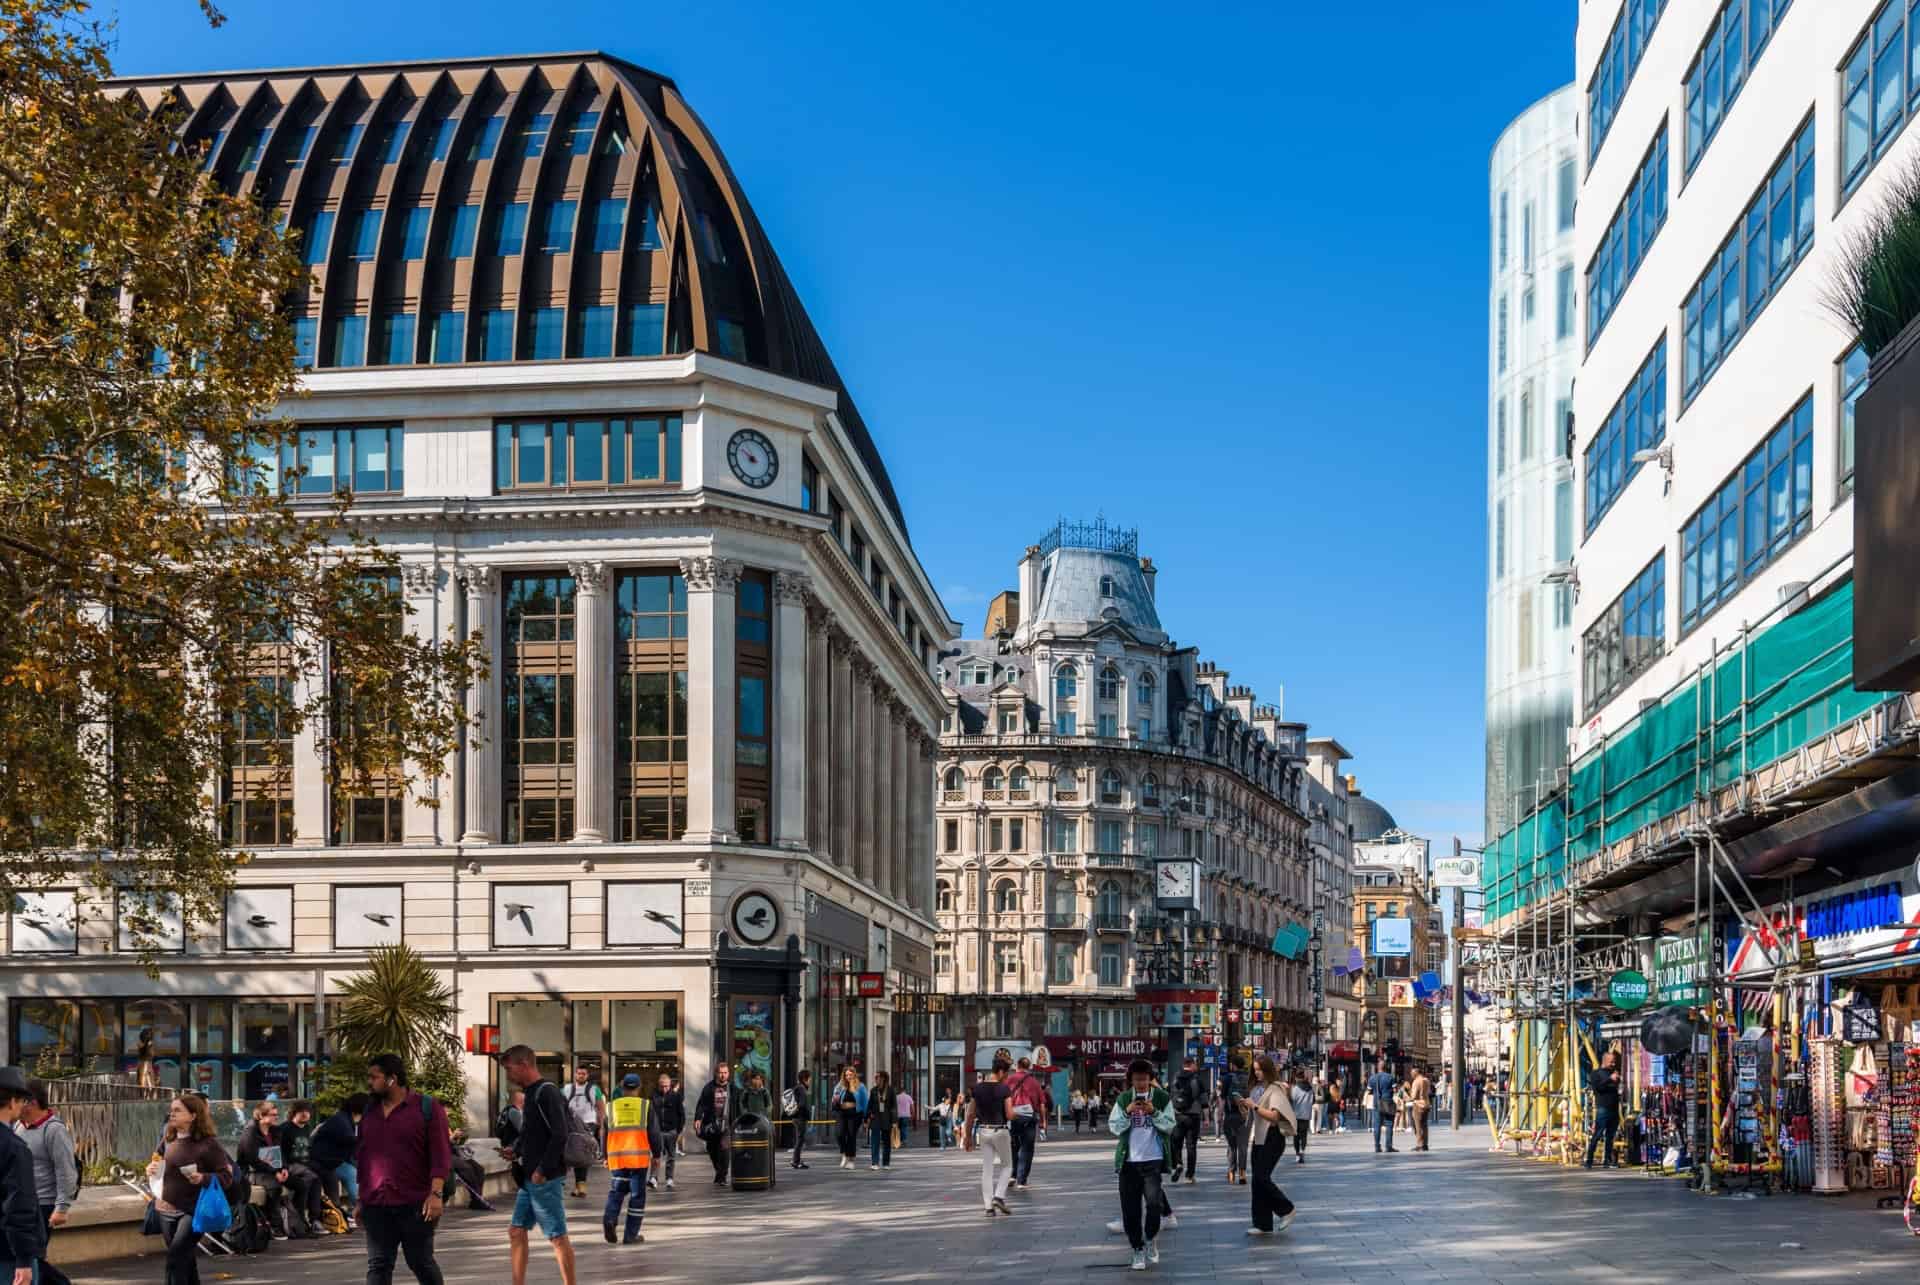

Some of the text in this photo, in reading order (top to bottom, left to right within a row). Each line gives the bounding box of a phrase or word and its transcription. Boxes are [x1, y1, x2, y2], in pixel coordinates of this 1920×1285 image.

[1660, 941, 1682, 963] WEST
[1656, 967, 1675, 988] FOOD
[1675, 966, 1681, 984] &
[1611, 982, 1646, 993] TOBACCO
[1081, 1040, 1103, 1054] PRET
[1113, 1040, 1145, 1054] MANGER
